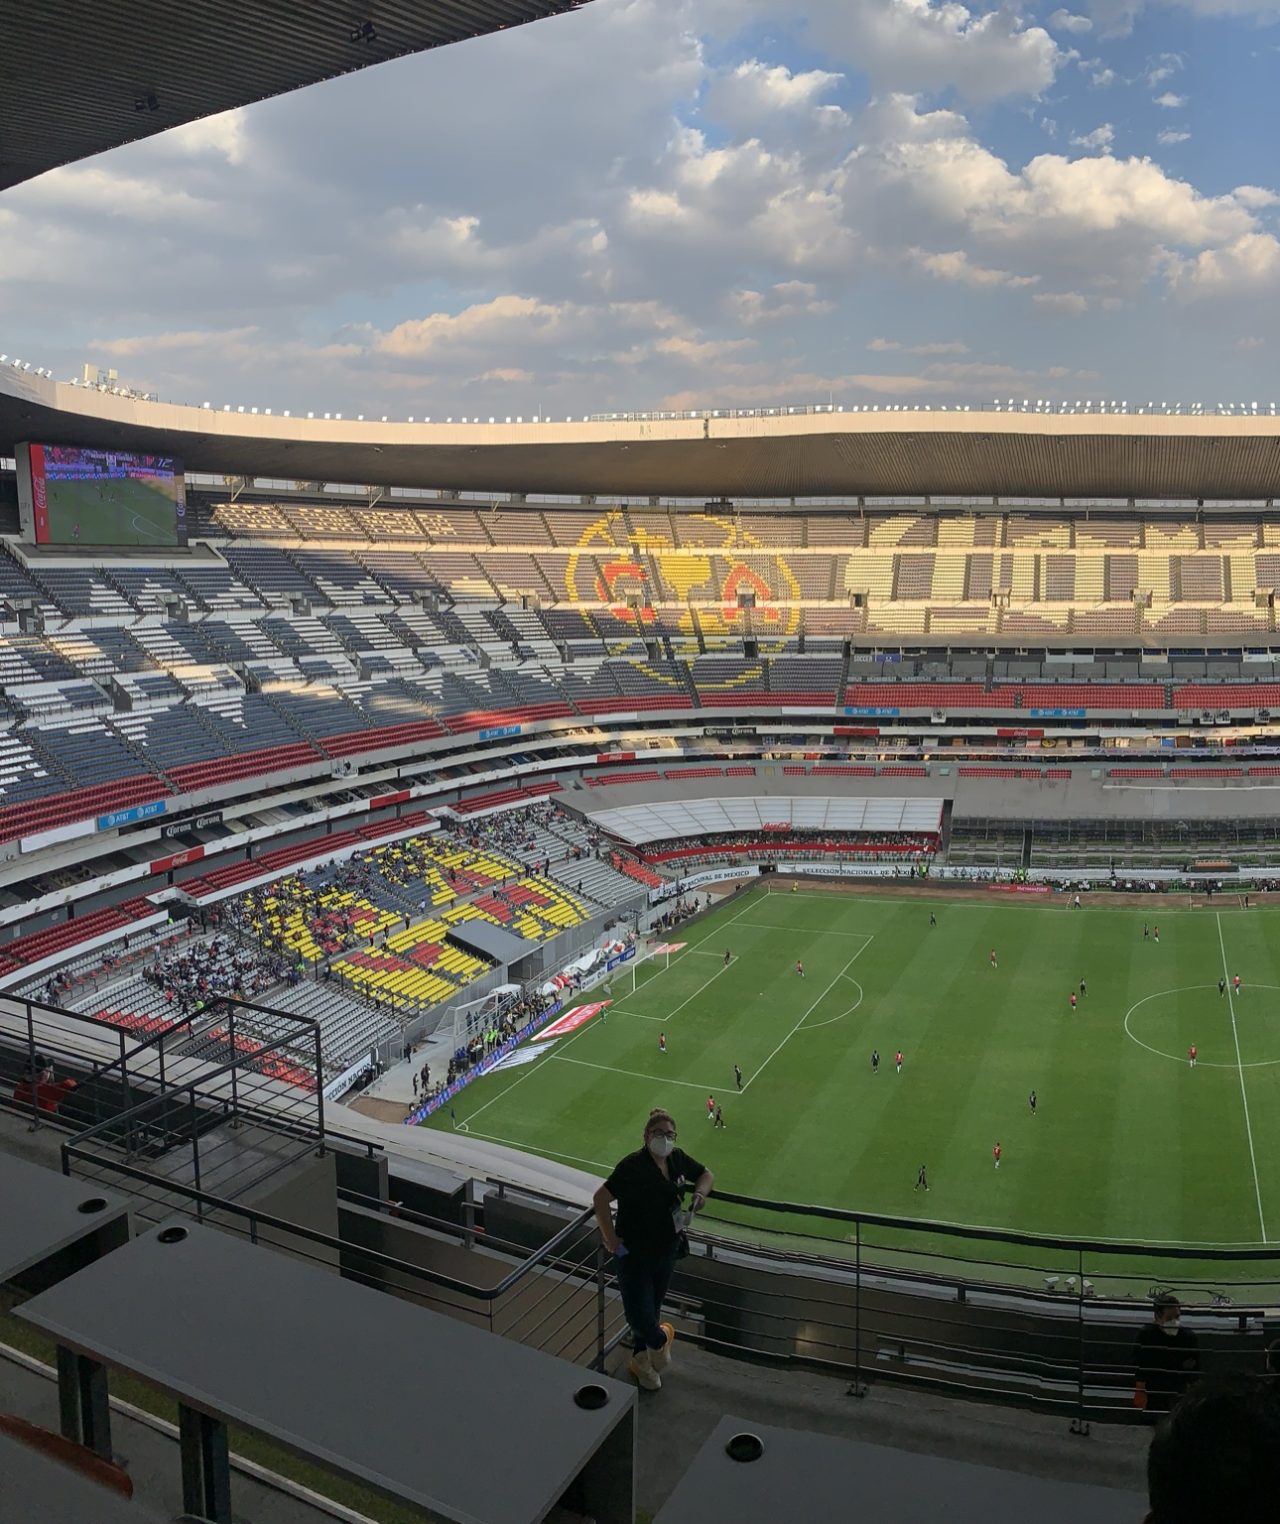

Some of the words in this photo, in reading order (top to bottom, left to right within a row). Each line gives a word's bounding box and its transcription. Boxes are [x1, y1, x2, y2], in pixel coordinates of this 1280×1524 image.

[115, 812, 129, 822] AT&T
[144, 804, 158, 815] AT&T
[166, 822, 192, 838] Corona
[196, 815, 220, 829] Corona
